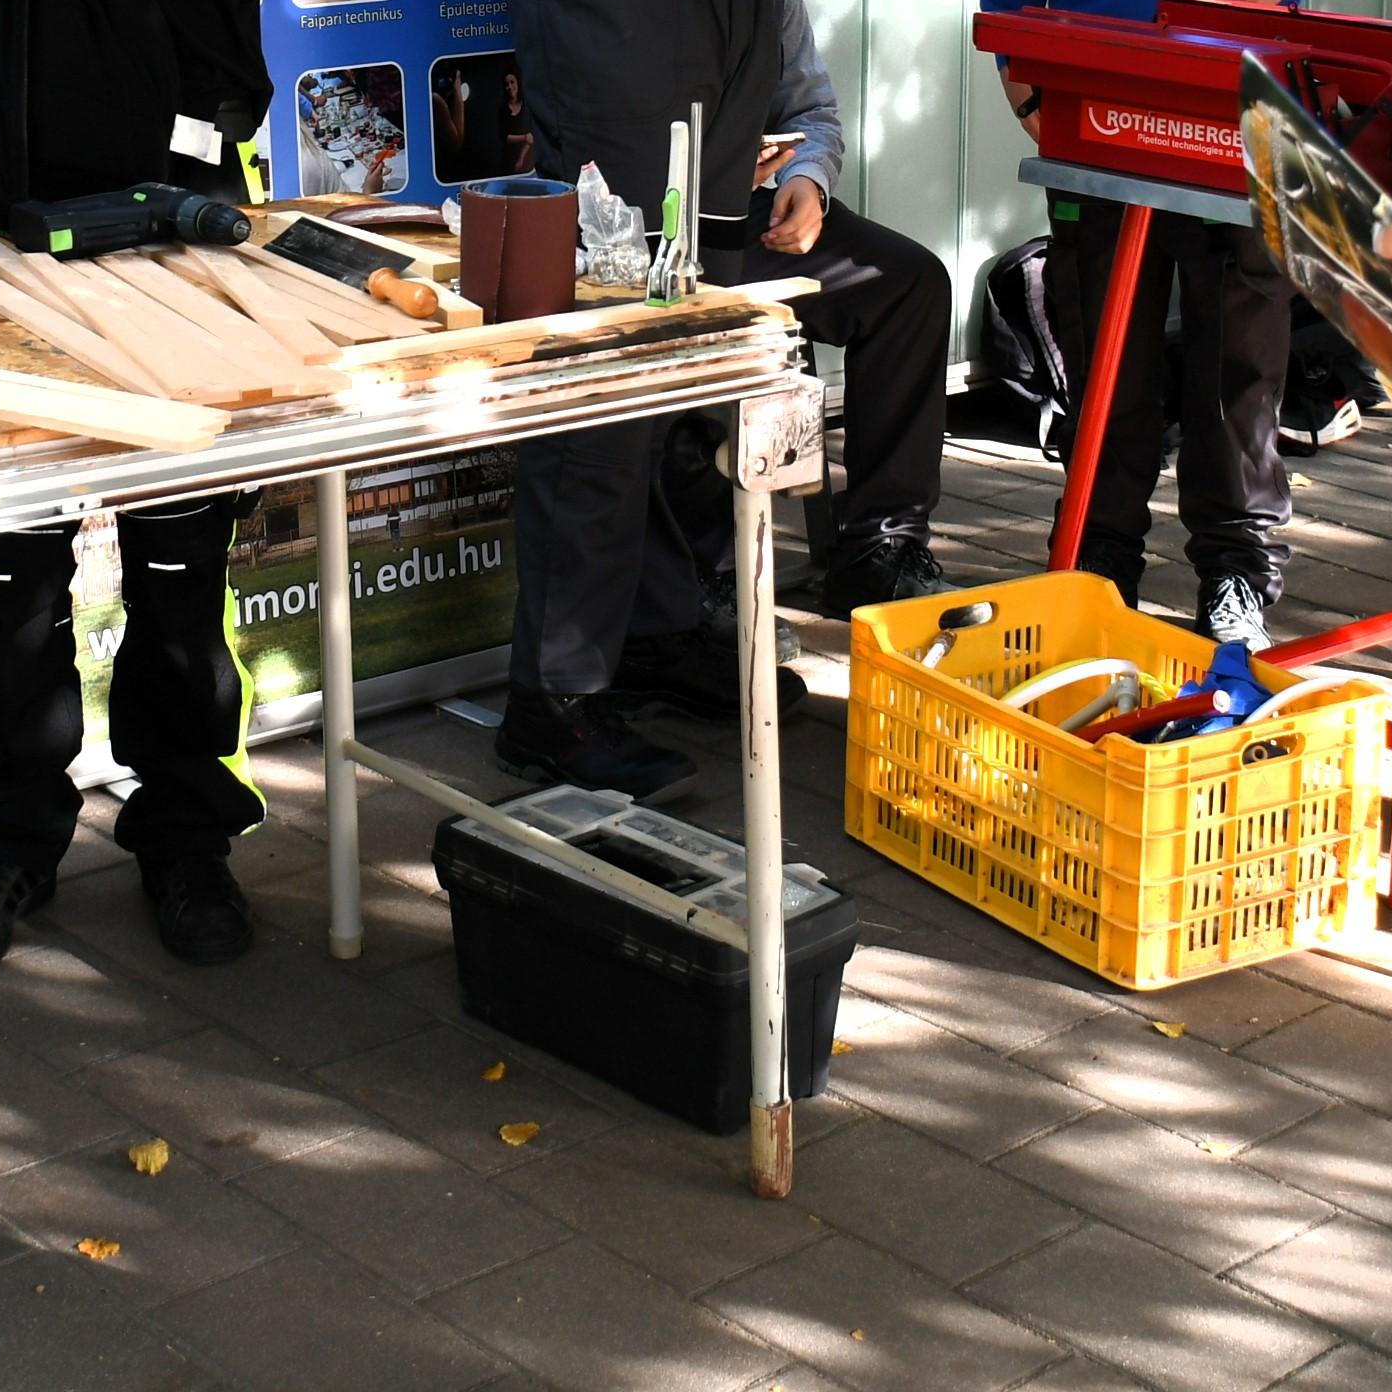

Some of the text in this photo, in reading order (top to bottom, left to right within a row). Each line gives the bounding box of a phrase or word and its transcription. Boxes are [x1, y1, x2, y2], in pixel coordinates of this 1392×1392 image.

[300, 7, 403, 30] Faipari technikus
[439, 0, 508, 19] Épületgépé
[451, 21, 510, 39] technikus
[1107, 110, 1243, 148] ROTHENBERGE
[1137, 133, 1170, 147] Pipetool
[1171, 138, 1224, 156] technologies
[1225, 149, 1235, 158] at
[210, 227, 254, 252] 508
[218, 343, 259, 362] PÉCS
